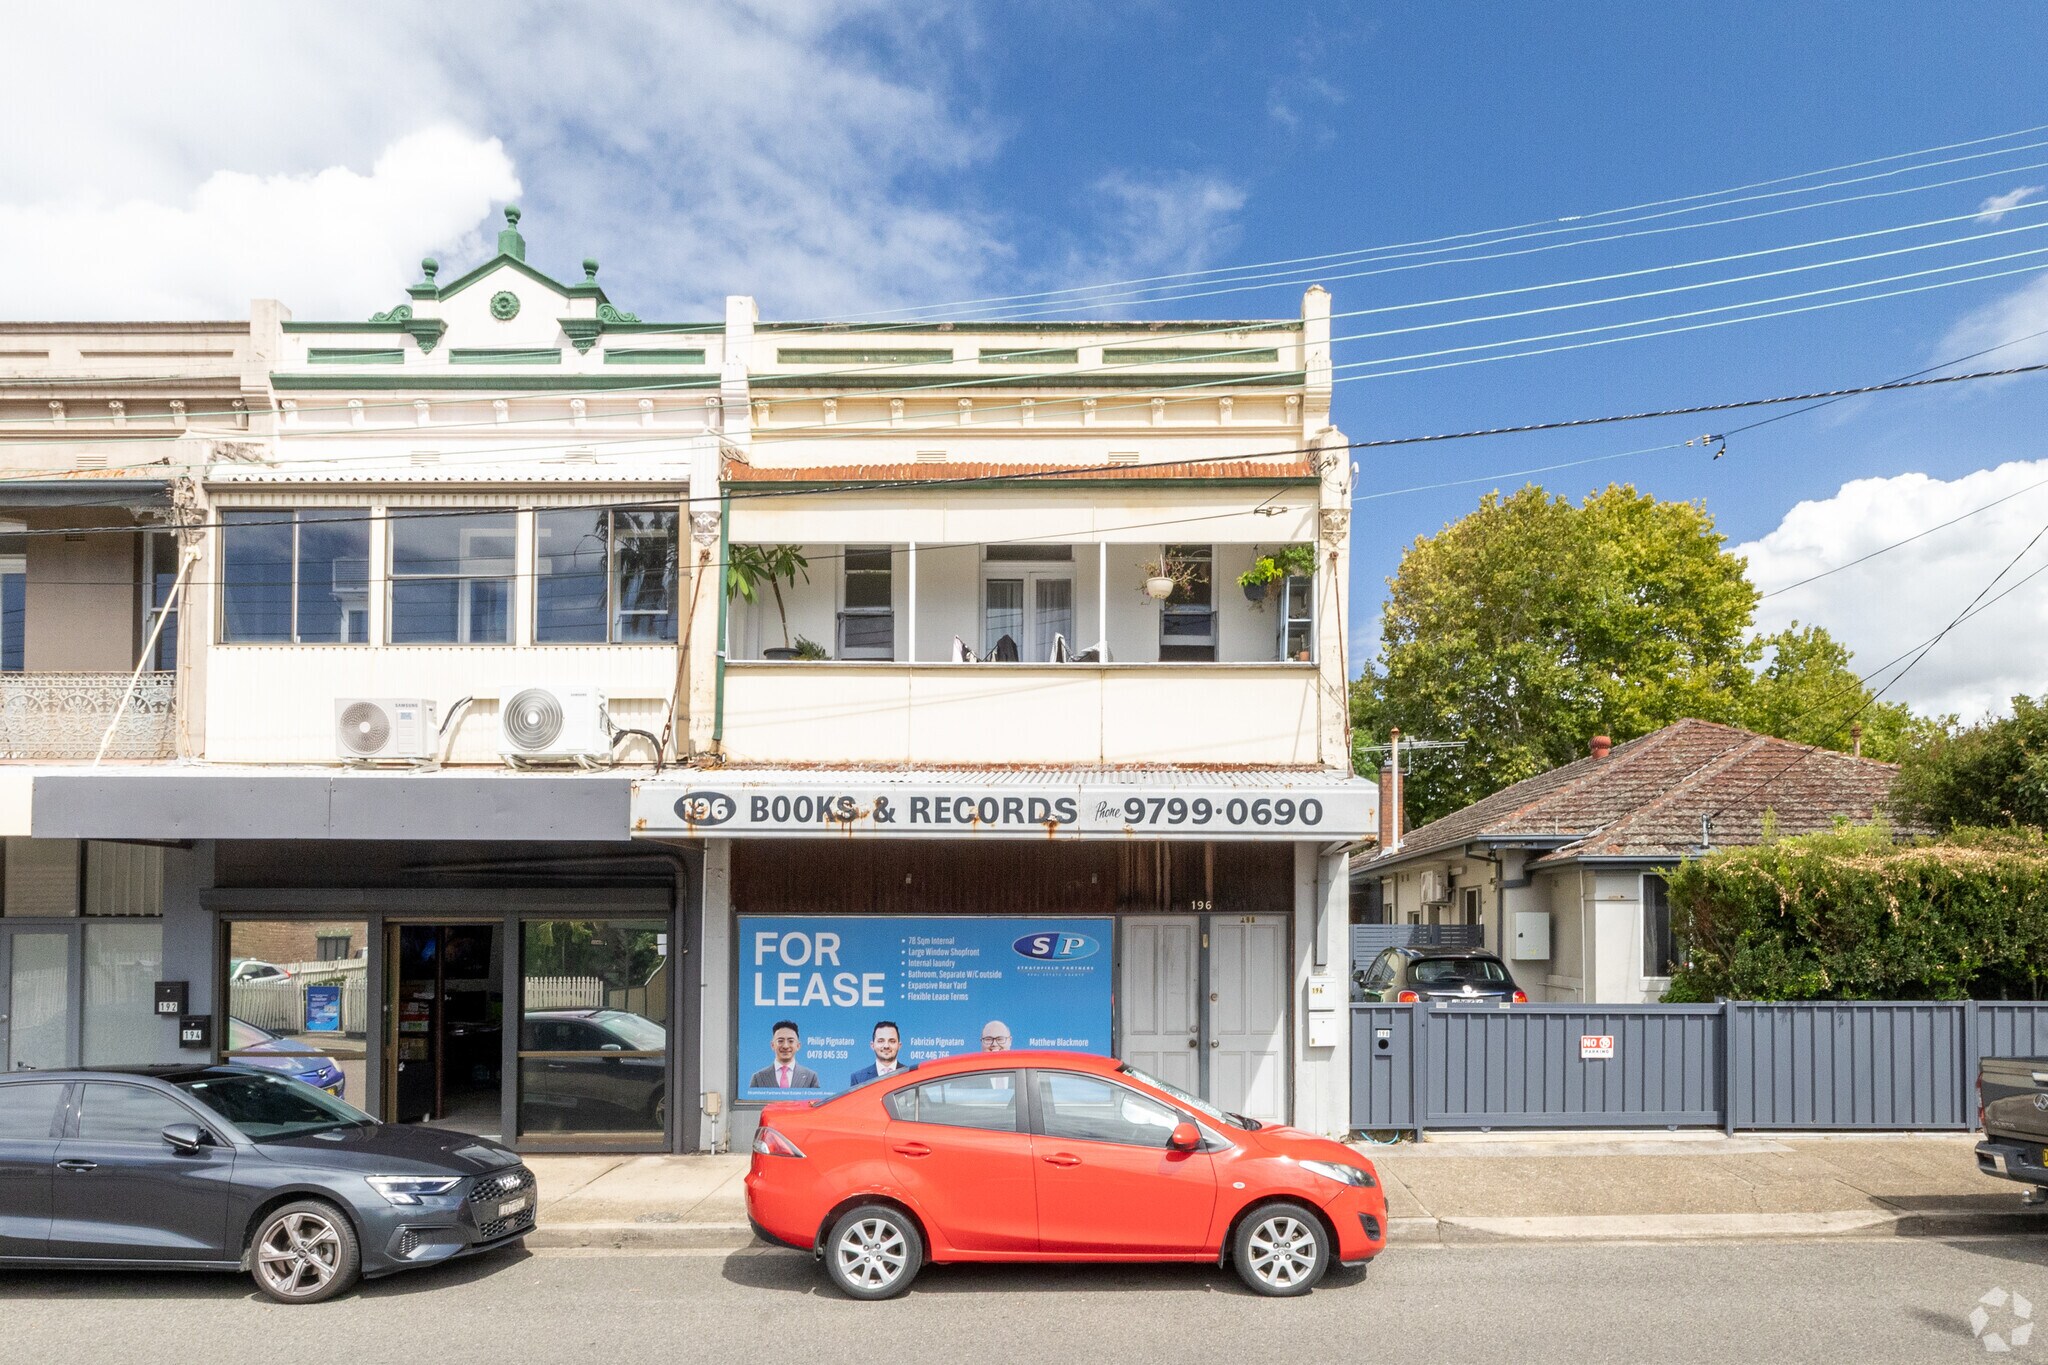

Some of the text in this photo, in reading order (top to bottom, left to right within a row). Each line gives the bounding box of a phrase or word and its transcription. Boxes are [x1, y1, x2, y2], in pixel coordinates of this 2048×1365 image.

[682, 797, 729, 820] 196
[750, 795, 857, 823] BOOKS
[872, 795, 896, 823] &
[910, 796, 1078, 824] RECORDS
[1095, 800, 1122, 821] Phone
[1191, 900, 1212, 910] 196
[908, 936, 955, 946] 78 Sqm Internal
[755, 931, 841, 967] FOR
[908, 948, 980, 957] Large Window Shopfront
[908, 959, 932, 967] Internal
[939, 970, 966, 979] Separate
[966, 970, 979, 979] W/C
[979, 970, 1002, 979] outside
[755, 972, 886, 1008] LEASE
[908, 981, 967, 990] Expansive Rear Yard
[907, 992, 969, 1001] Flexible Lease Terms
[160, 1002, 177, 1011] 192
[184, 1030, 200, 1039] 194
[807, 1037, 855, 1048] Philip Pignataro
[910, 1037, 965, 1048] Fabrizio Pignataro
[1029, 1038, 1089, 1047] Matthew Blackmore
[1584, 1038, 1597, 1048] NO
[807, 1050, 848, 1059] 0478 845 359
[910, 1050, 925, 1060] 0412
[925, 1050, 937, 1059] 446
